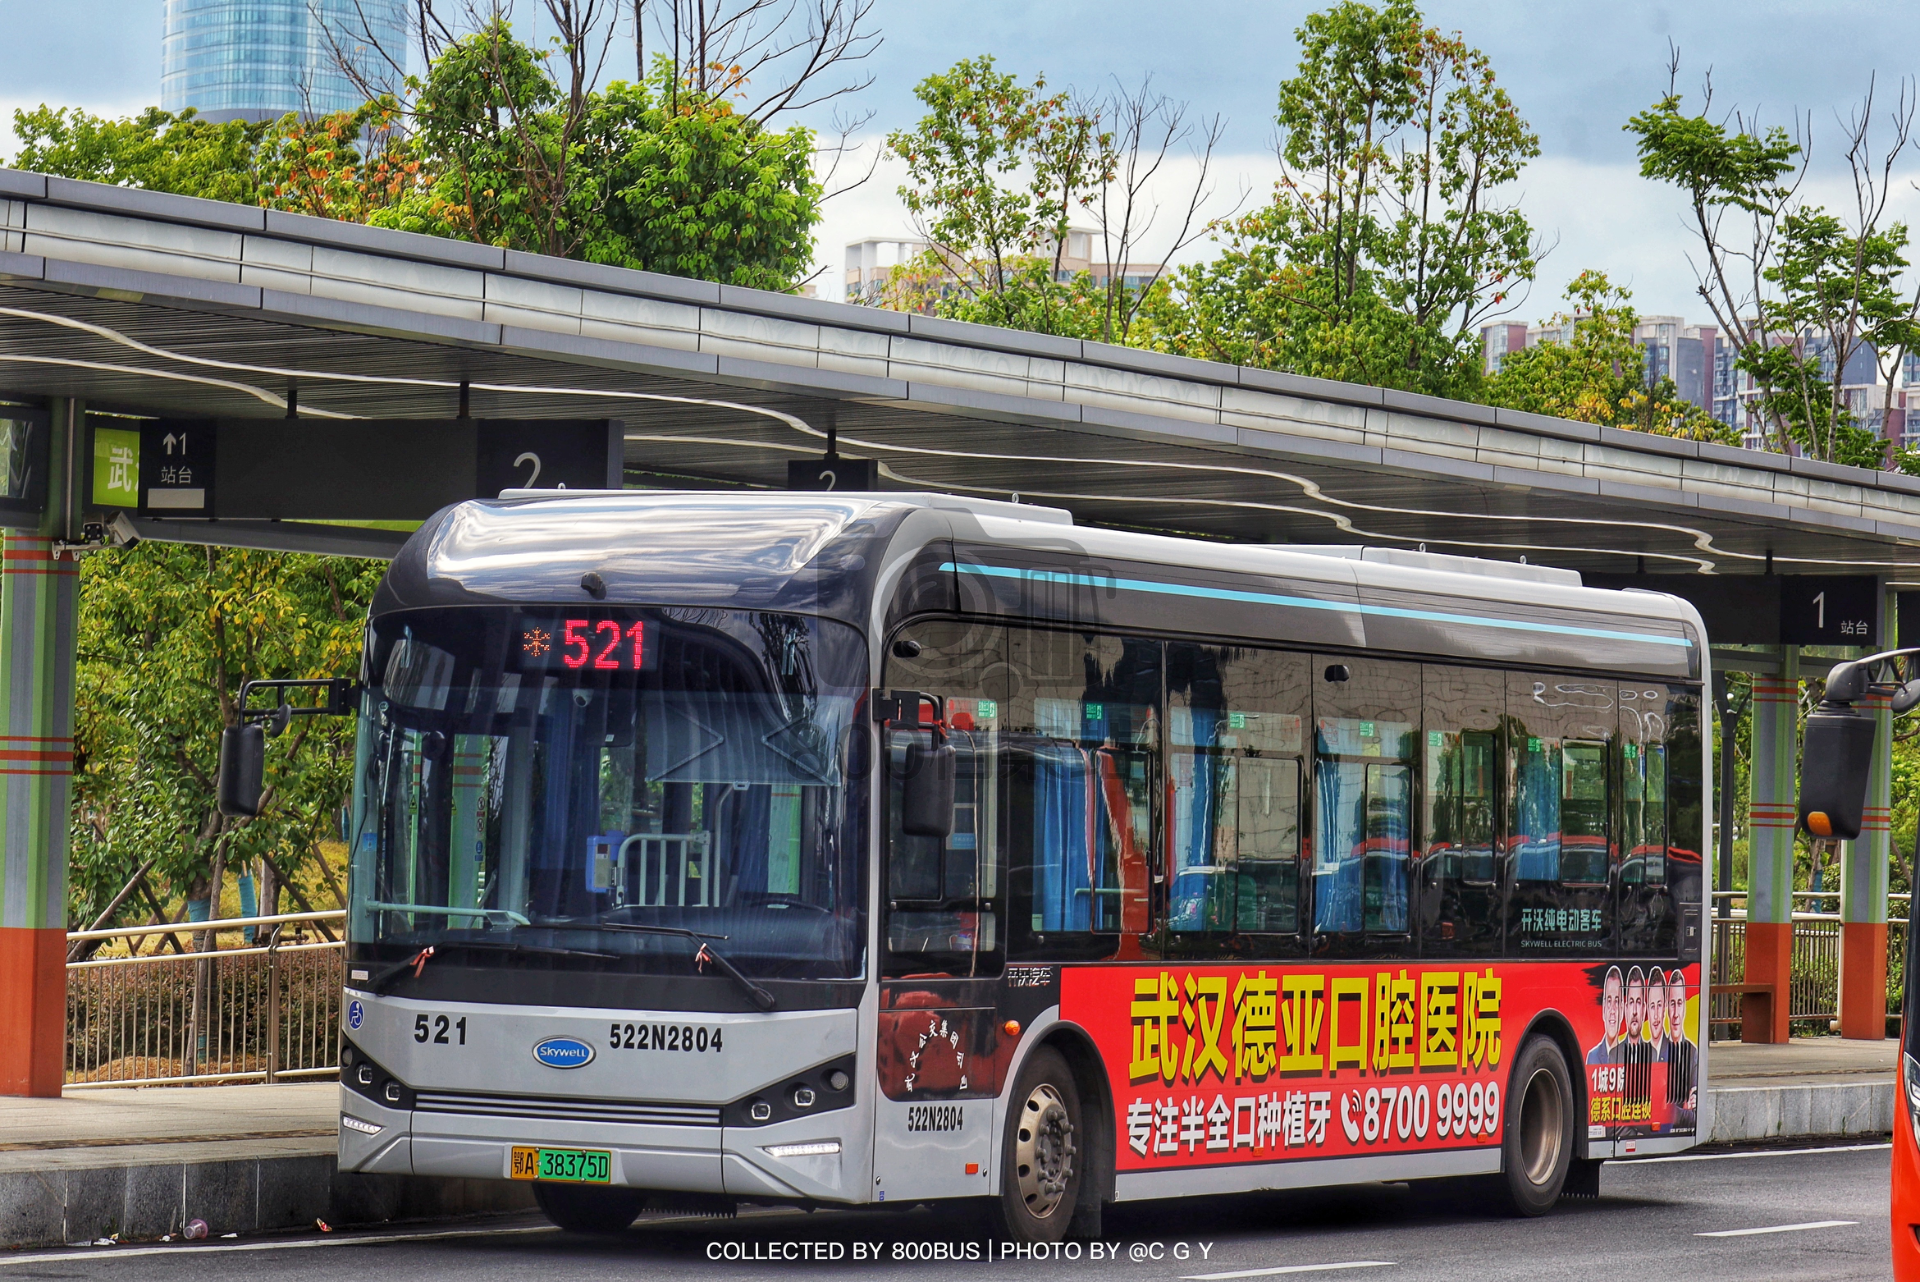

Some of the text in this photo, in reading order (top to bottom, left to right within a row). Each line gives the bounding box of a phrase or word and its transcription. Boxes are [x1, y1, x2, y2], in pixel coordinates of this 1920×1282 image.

[178, 432, 187, 455] 1
[107, 446, 139, 493] 武
[160, 465, 193, 484] 站台
[513, 451, 541, 489] 2
[819, 470, 836, 492] 2
[1812, 591, 1869, 635] 1 站台
[564, 619, 644, 669] 521
[1521, 908, 1602, 932] 开沃纯电动客车
[1520, 940, 1602, 948] SKYWELL ELECTRIC BUS
[413, 1014, 467, 1045] 521
[609, 1023, 723, 1053] 522N2804
[1128, 967, 1503, 1081] 武汉德亚口腔医院
[907, 1106, 963, 1132] 522N2804
[1126, 1081, 1500, 1156] 专注半全口种植牙 8700 9999
